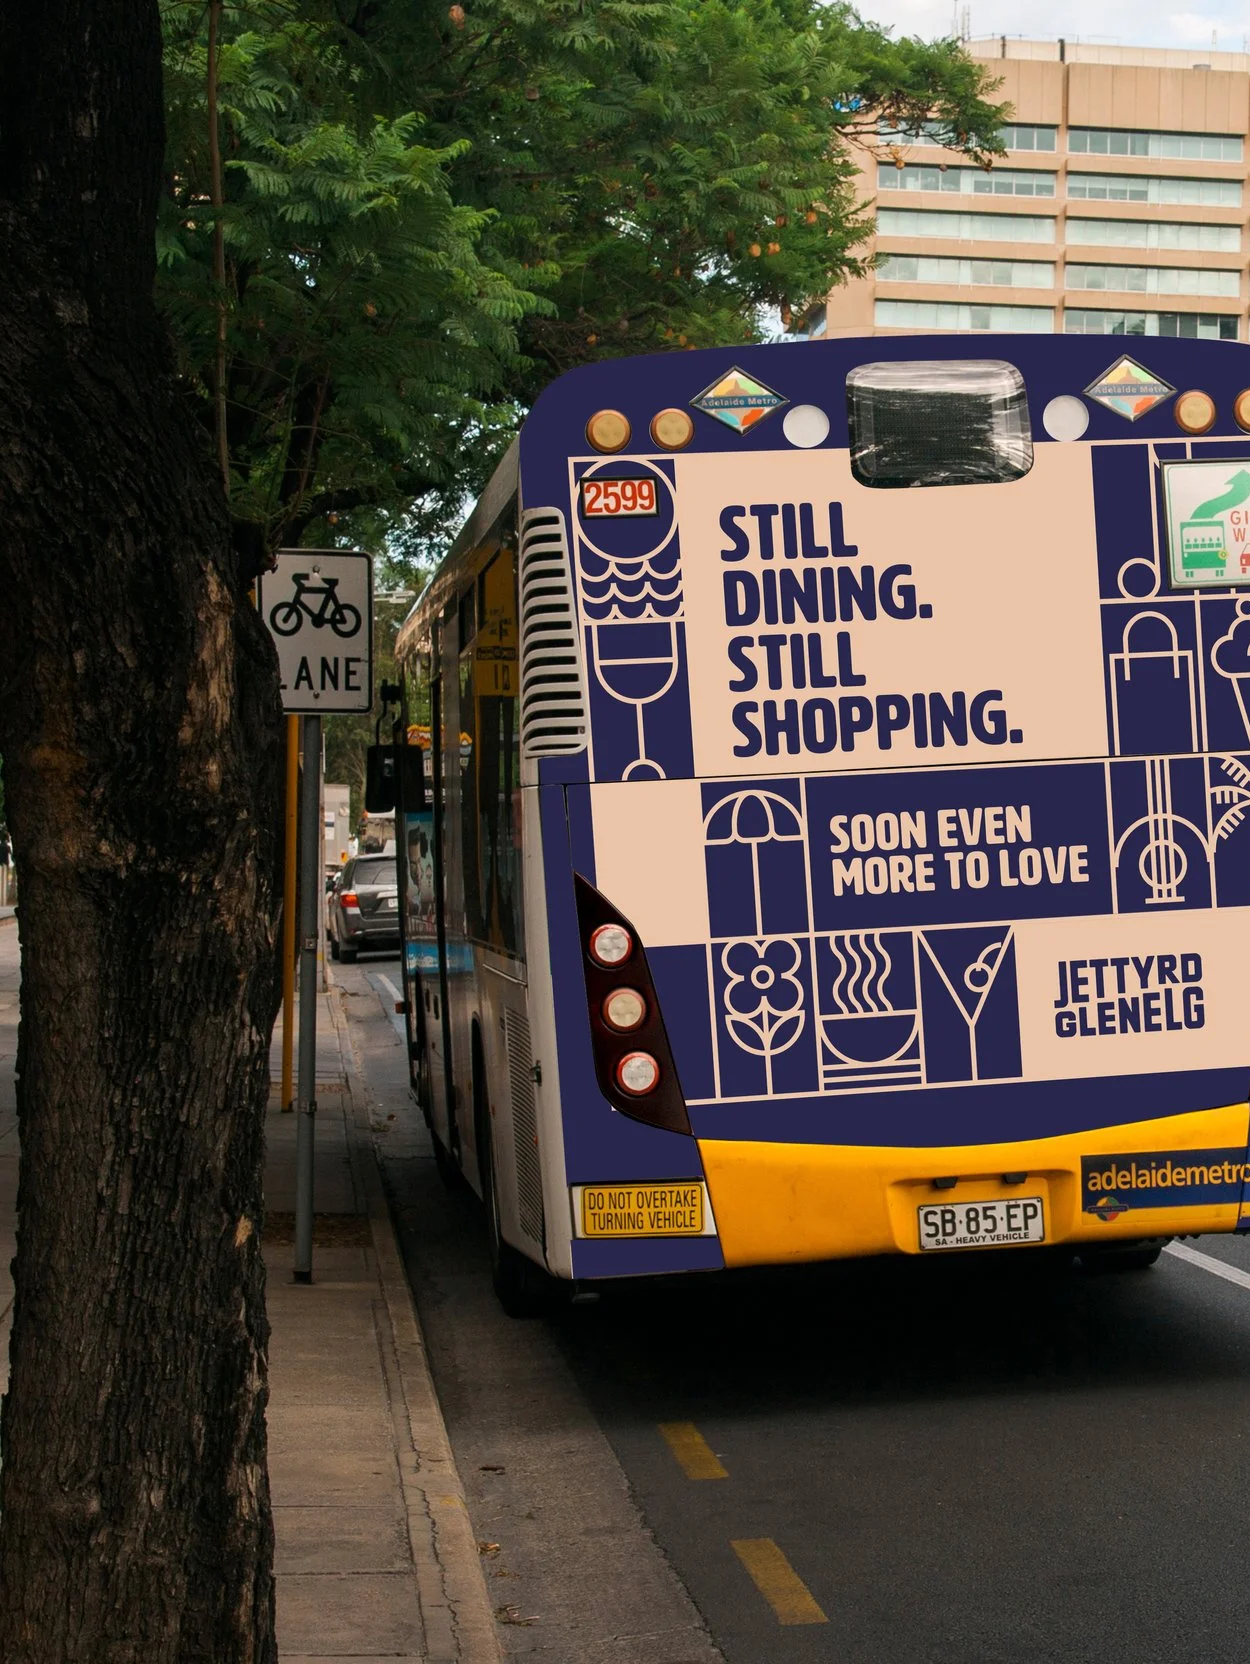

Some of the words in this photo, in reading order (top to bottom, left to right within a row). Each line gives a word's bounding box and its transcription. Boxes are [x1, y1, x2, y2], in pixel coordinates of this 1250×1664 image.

[701, 399, 744, 407] Adelaide
[747, 397, 777, 405] Metro
[1095, 385, 1137, 394] Adelaide
[1140, 385, 1168, 393] Metro
[585, 480, 655, 514] 2599
[719, 501, 858, 562] STILL
[723, 564, 933, 626] DINING.
[728, 631, 866, 692] STILL
[732, 689, 1023, 757] SHOPPING.
[829, 810, 927, 853] SOON
[937, 805, 1032, 847] EVEN
[832, 853, 936, 897] MORE
[944, 851, 990, 890] TO
[999, 845, 1090, 887] LOVE
[1055, 986, 1205, 1038] GLENELG
[588, 1192, 605, 1210] DO
[608, 1191, 633, 1209] NOT
[636, 1189, 697, 1209] OVERTAKE
[590, 1211, 644, 1230] TURNING
[647, 1210, 696, 1229] VEHICLE
[955, 1235, 987, 1244] HEAVY
[989, 1231, 1030, 1242] VEHICLE
